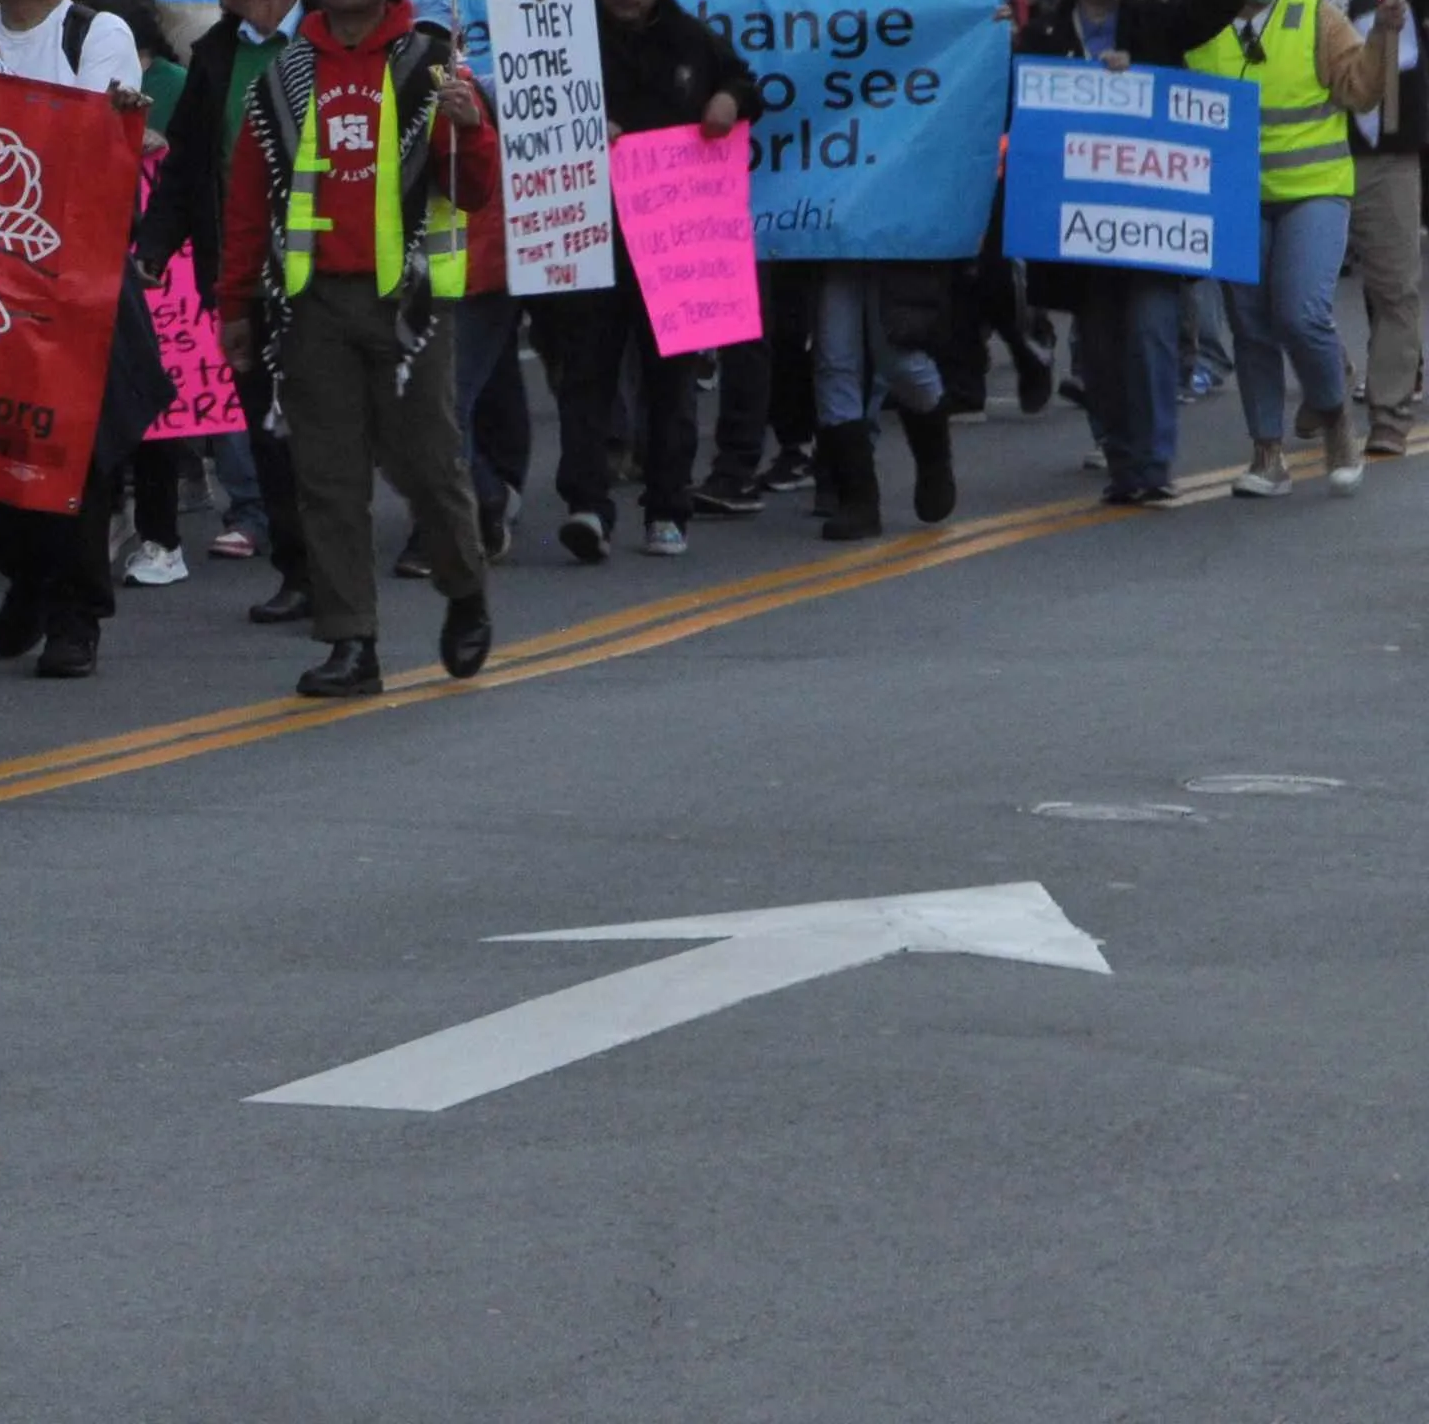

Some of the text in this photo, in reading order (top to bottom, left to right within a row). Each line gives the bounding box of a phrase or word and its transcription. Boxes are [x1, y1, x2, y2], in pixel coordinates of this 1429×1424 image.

[520, 2, 574, 39] THEY
[701, 0, 914, 59] hange
[500, 48, 573, 79] DO THE
[502, 78, 601, 121] JOBS YOU
[823, 67, 940, 111] see
[1021, 72, 1228, 126] RESIST the
[328, 115, 374, 151] PSL
[503, 116, 605, 163] WON'T DO!
[561, 160, 597, 189] BITE
[510, 201, 587, 236] THE HANDS
[1064, 209, 1210, 254] Agenda
[517, 242, 555, 266] THAT
[563, 221, 610, 253] FEEDS
[544, 263, 578, 288] YOU!
